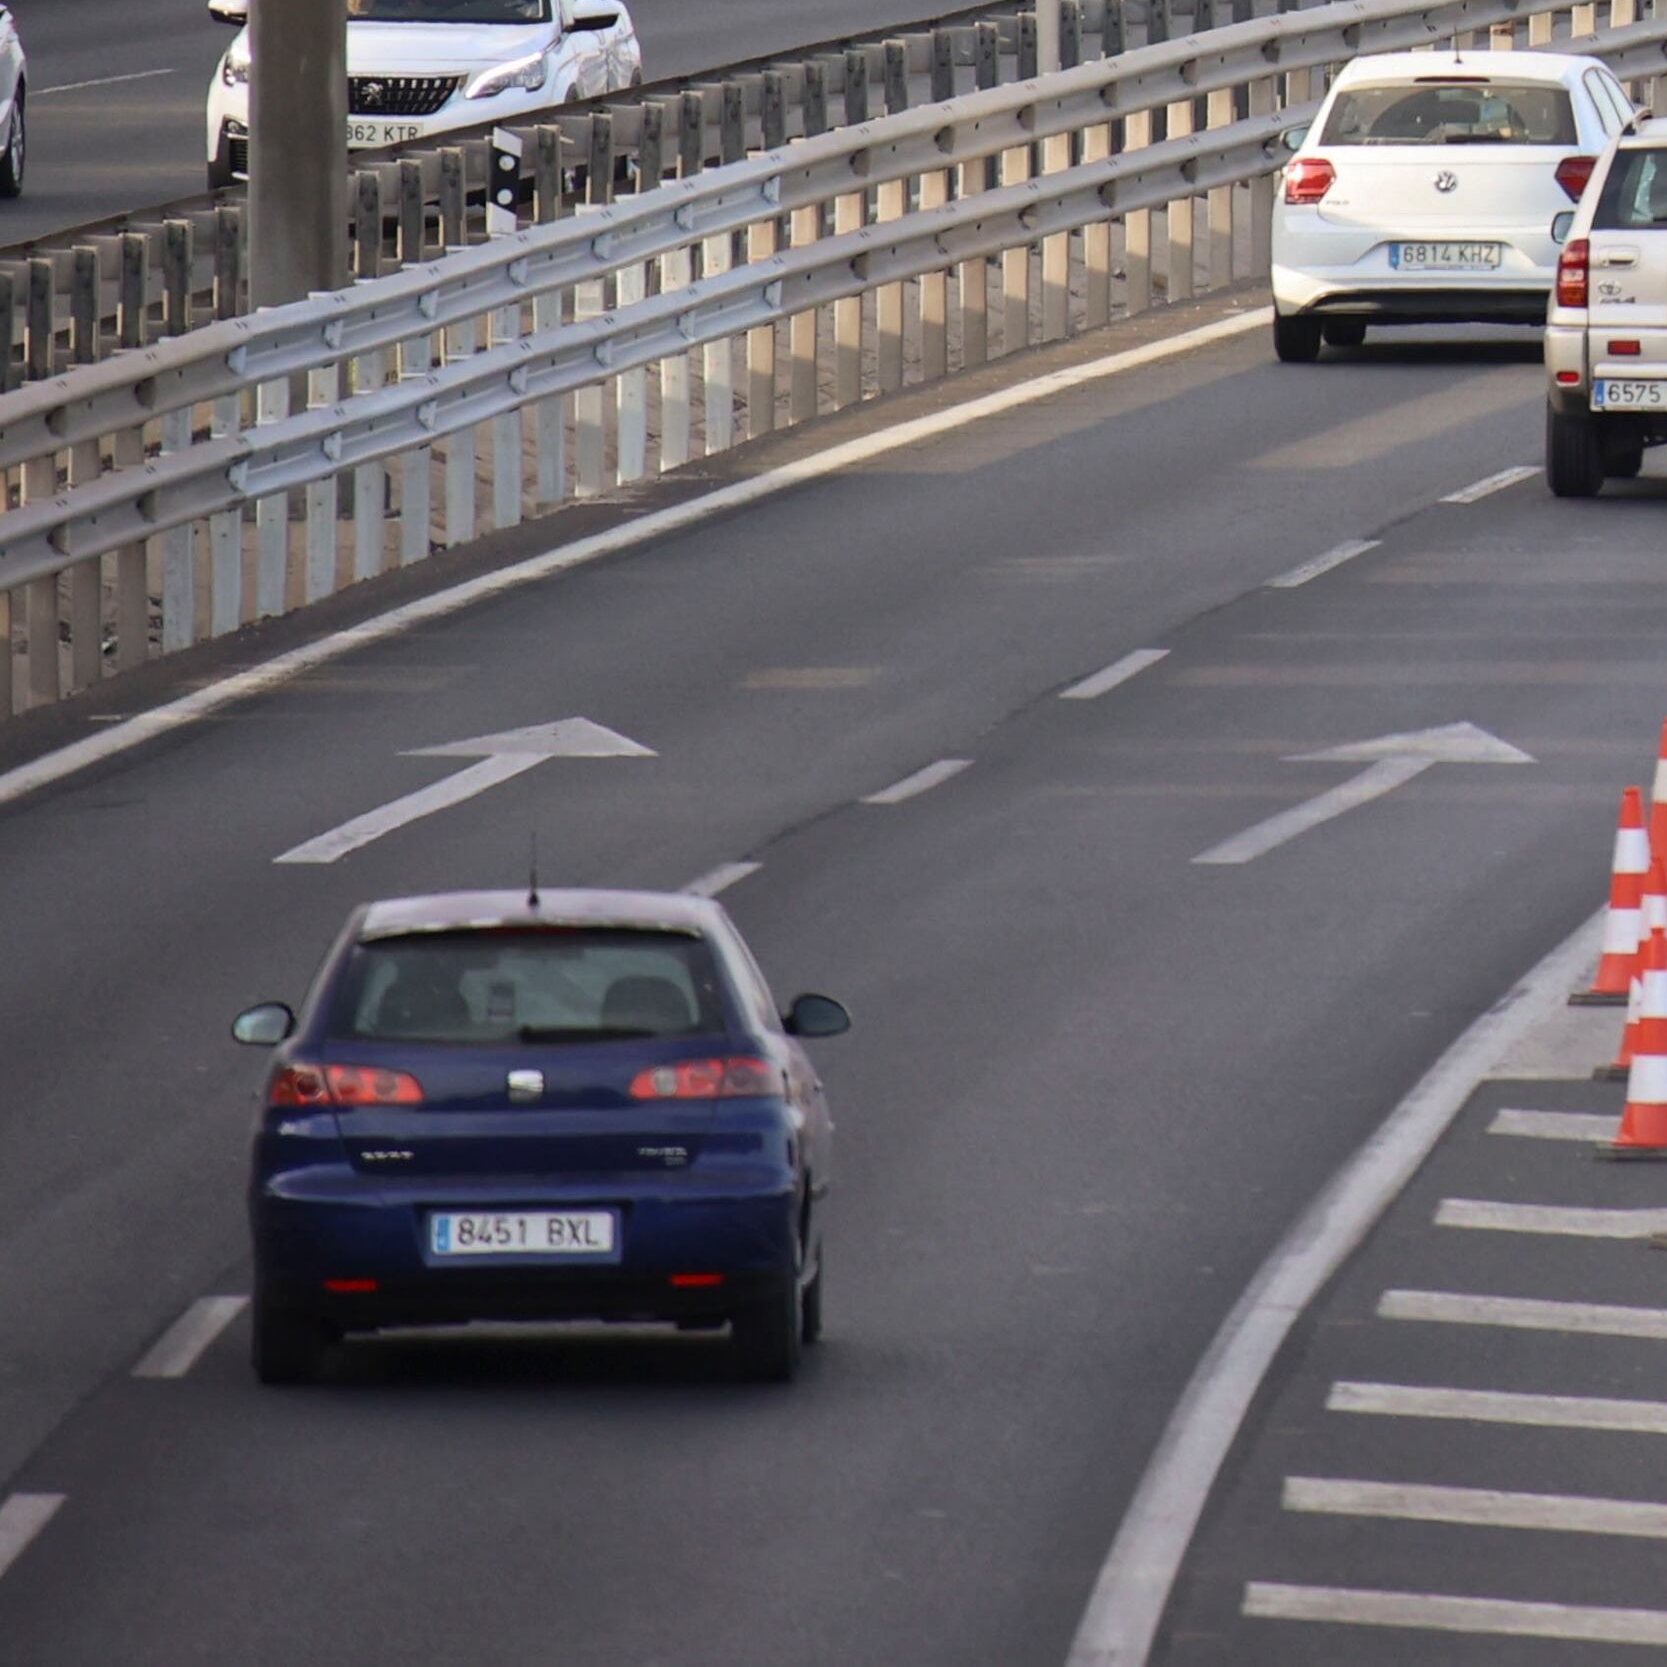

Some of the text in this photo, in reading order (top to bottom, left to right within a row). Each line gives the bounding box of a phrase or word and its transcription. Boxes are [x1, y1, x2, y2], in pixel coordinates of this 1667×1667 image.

[384, 126, 418, 142] KTR
[1403, 245, 1495, 263] 6814 KHZ
[1608, 384, 1661, 403] 6575
[457, 1218, 600, 1246] 8451 BXL
